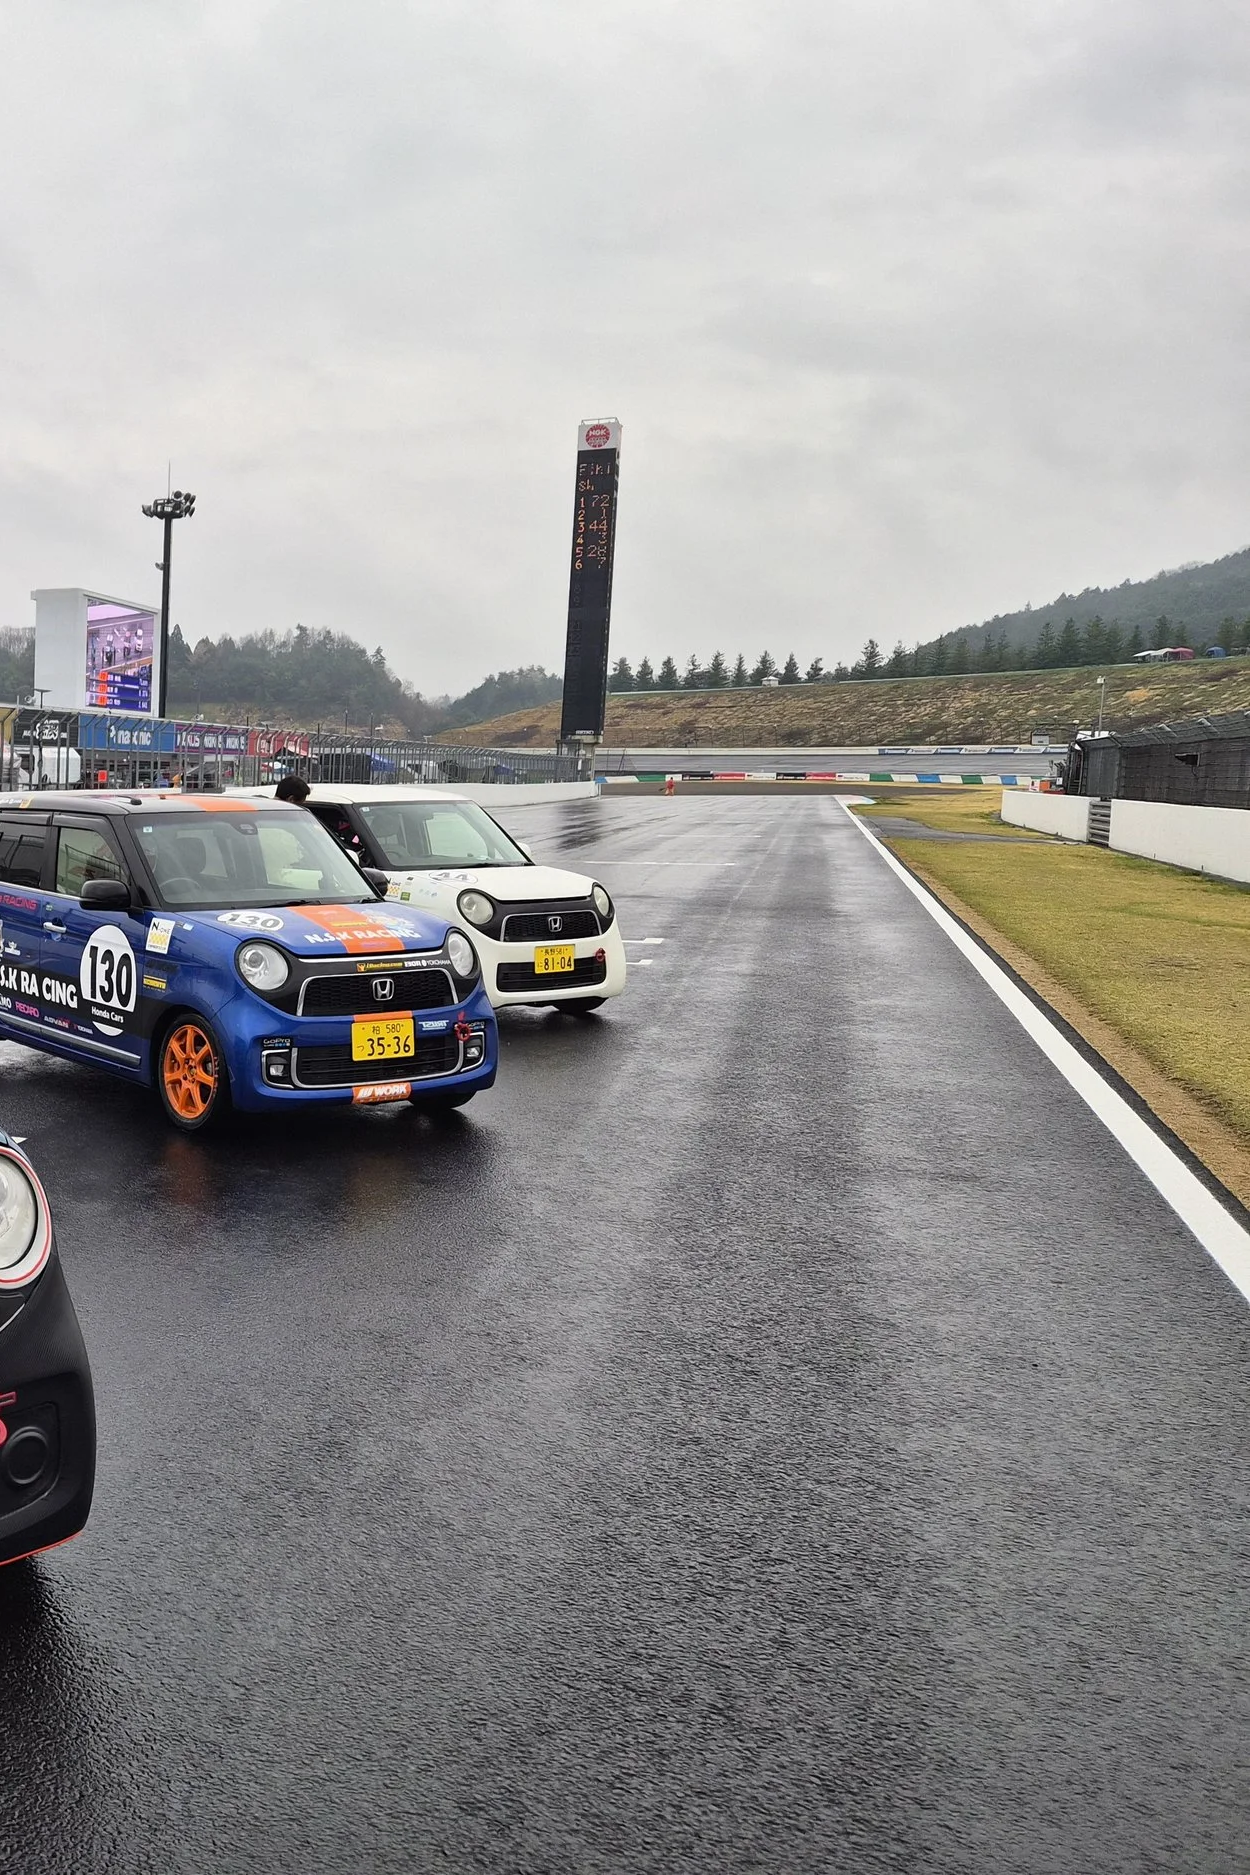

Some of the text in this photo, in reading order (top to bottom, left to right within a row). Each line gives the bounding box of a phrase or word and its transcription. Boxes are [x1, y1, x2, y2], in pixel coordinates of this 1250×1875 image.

[591, 495, 610, 507] 72
[589, 520, 608, 532] 44
[3, 894, 38, 911] RACING
[228, 912, 281, 929] 130
[353, 928, 421, 940] RACING
[89, 945, 133, 1008] 130
[15, 1000, 40, 1018] RECARO
[91, 1005, 124, 1024] Honda Cars
[386, 1023, 402, 1035] 580
[366, 1035, 412, 1057] 35-36
[374, 1084, 408, 1097] WORK
